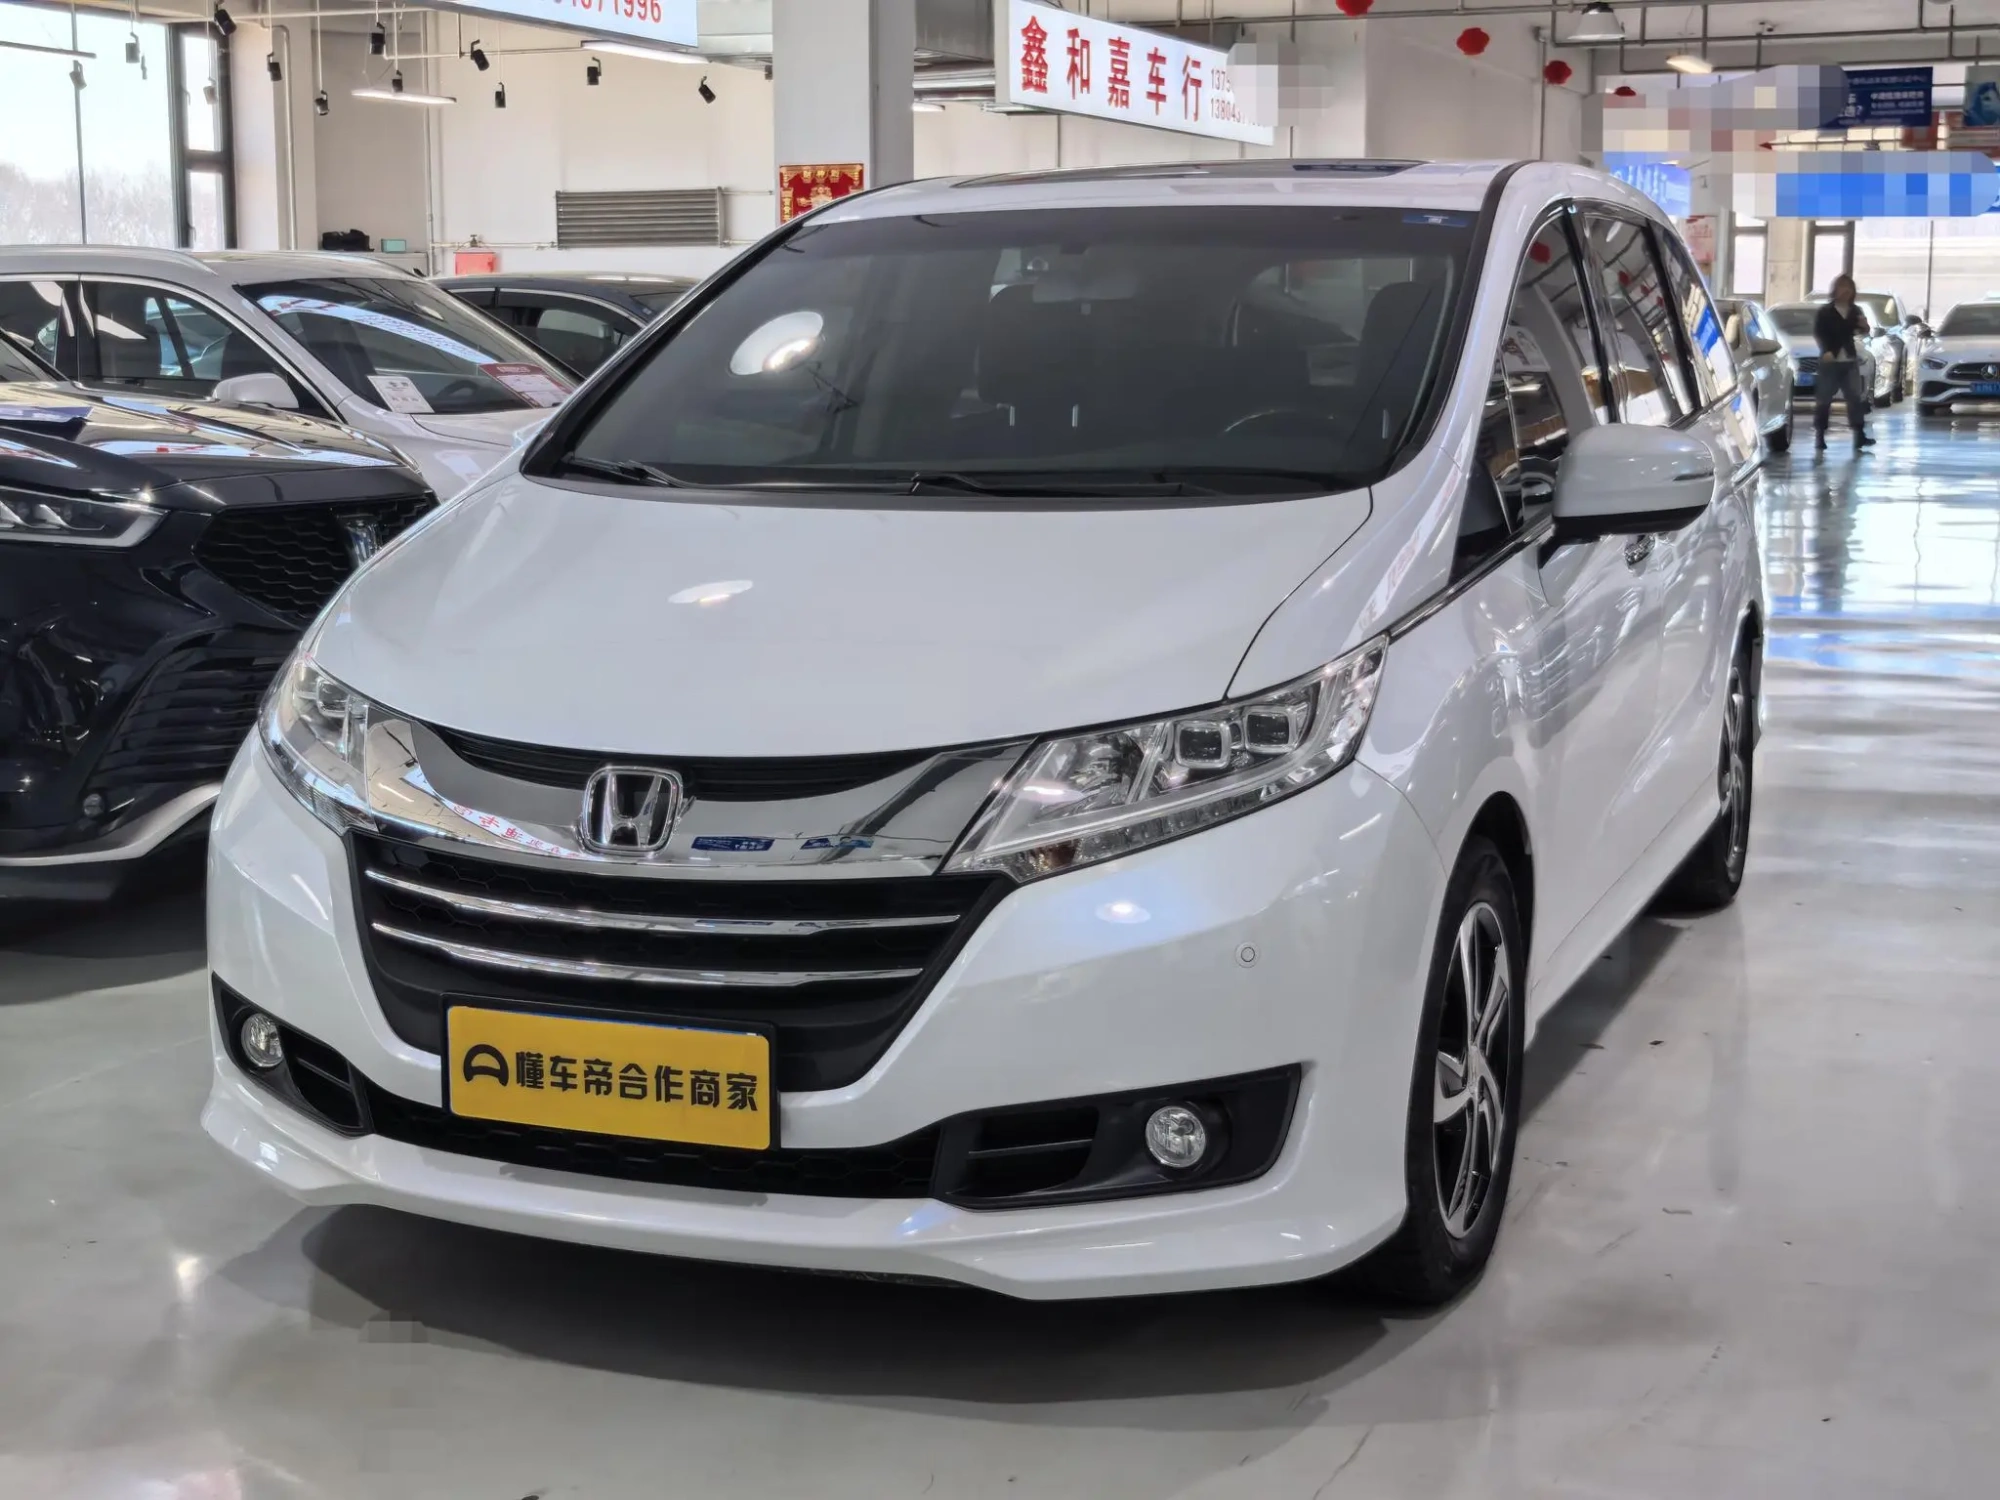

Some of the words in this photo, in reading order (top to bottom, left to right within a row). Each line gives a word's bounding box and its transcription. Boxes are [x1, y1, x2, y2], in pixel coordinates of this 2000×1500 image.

[1020, 15, 1202, 122] 鑫和嘉车行
[515, 1051, 759, 1112] 懂车帝合作商家
